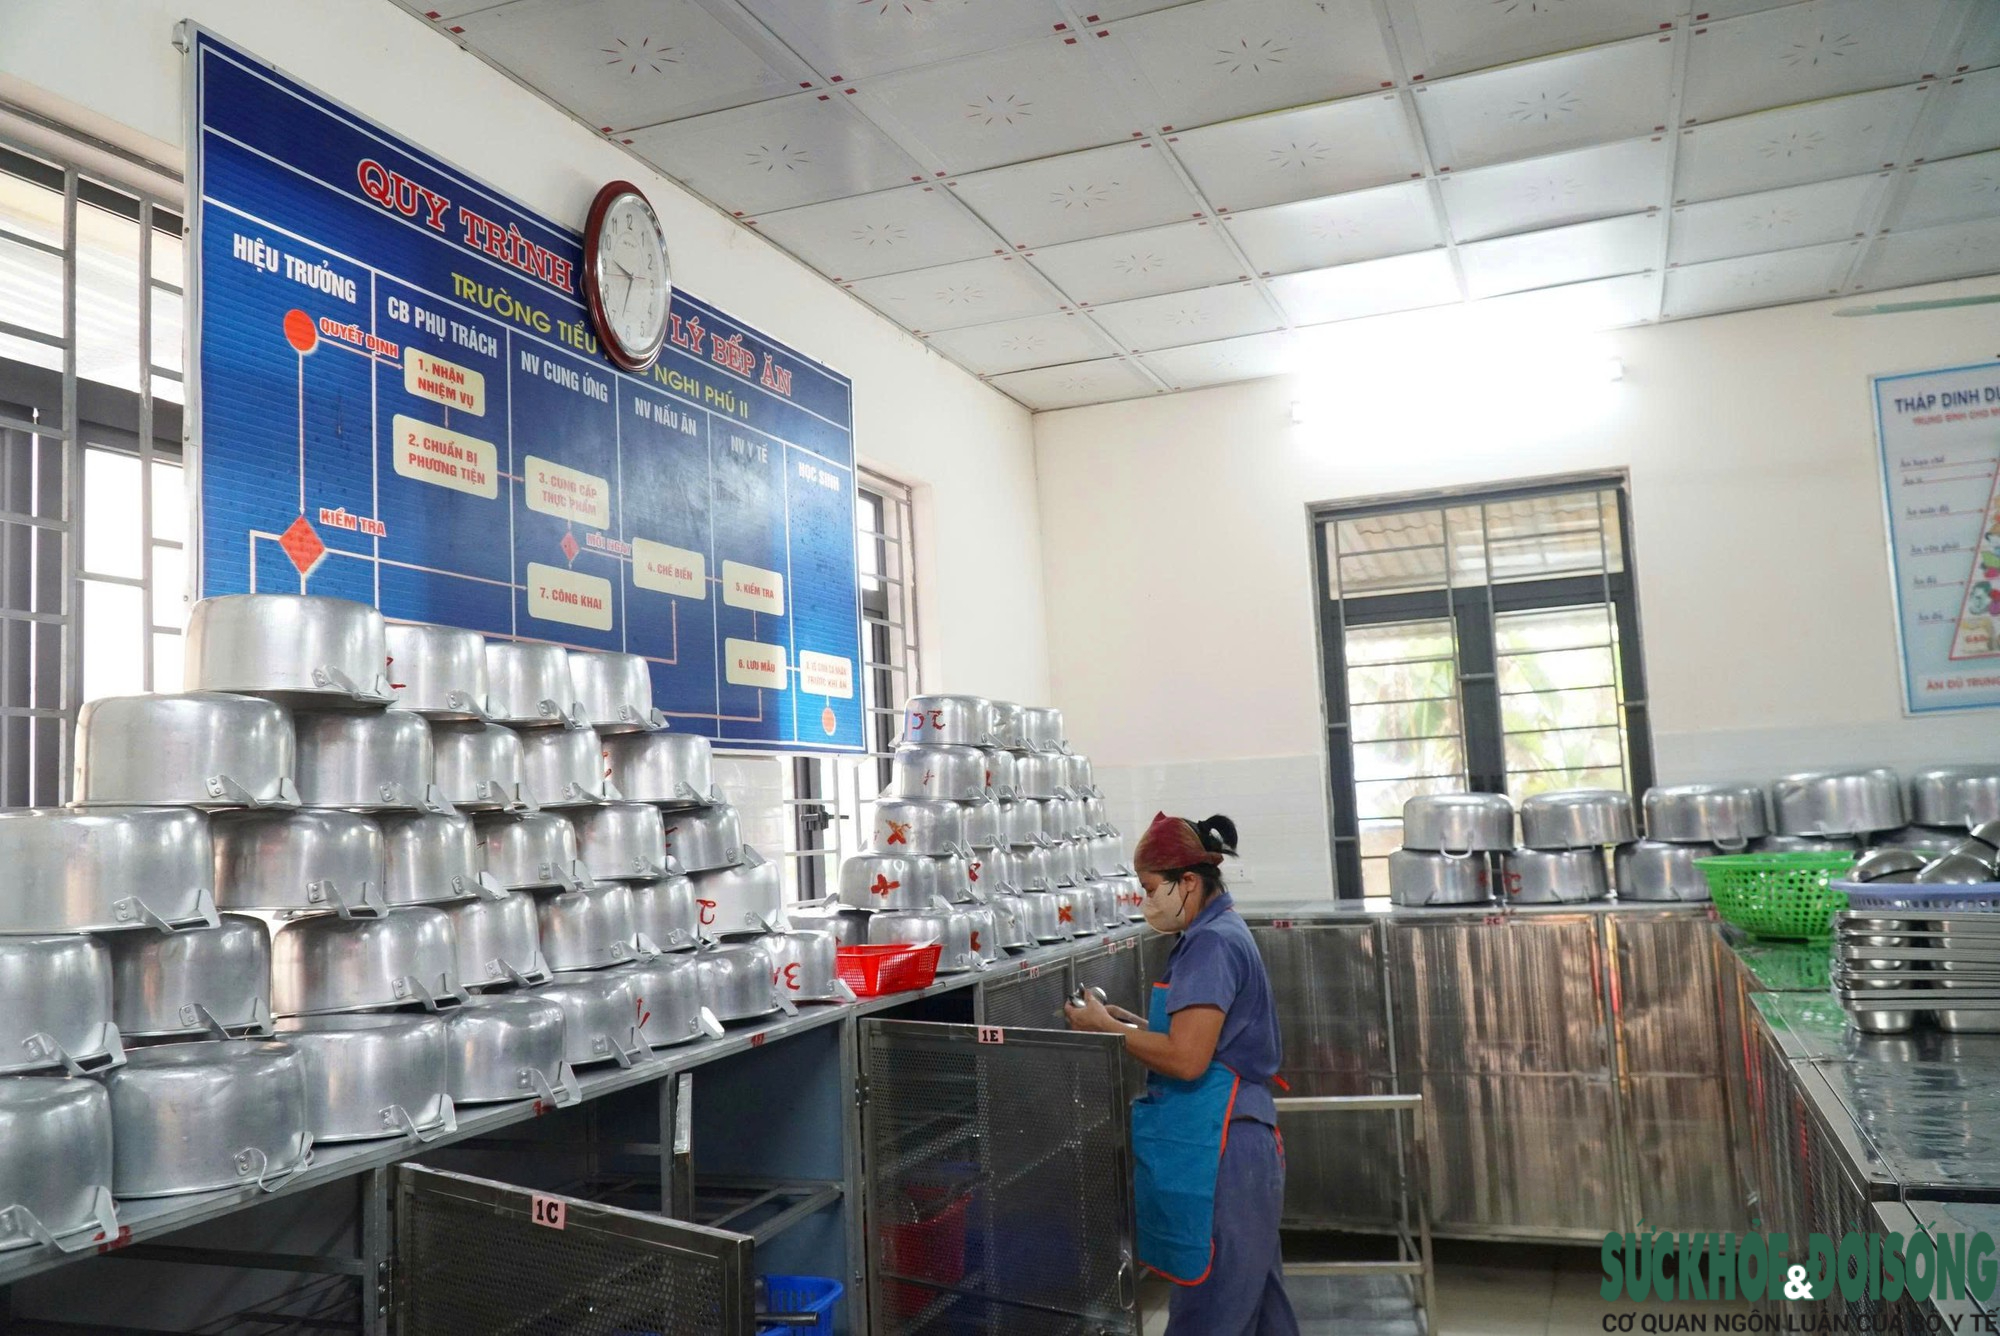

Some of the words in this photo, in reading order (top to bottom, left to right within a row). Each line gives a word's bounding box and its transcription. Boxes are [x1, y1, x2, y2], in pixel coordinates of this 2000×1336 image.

[357, 158, 450, 232] QUY
[459, 206, 573, 293] TRÌNH
[611, 217, 618, 235] 11
[625, 213, 633, 231] 12
[641, 231, 645, 247] 1
[232, 233, 279, 273] HIỆU
[284, 253, 357, 304] TRƯỞNG
[647, 253, 653, 270] 2
[604, 283, 609, 300] 8
[650, 279, 655, 296] 3
[450, 271, 552, 333] TRƯỜNG
[557, 320, 598, 354] TIỂU
[647, 303, 652, 319] 4
[319, 317, 364, 346] QUYẾT
[365, 333, 399, 359] ĐỊNH
[387, 296, 410, 324] CB
[414, 311, 447, 341] PHỤ
[449, 320, 498, 359] TRÁCH
[625, 325, 631, 341] 6
[640, 321, 645, 337] 5
[671, 314, 706, 354] LÝ
[711, 331, 756, 377] BẾP
[760, 353, 792, 396] ĂN
[418, 358, 429, 373] 1.
[432, 363, 465, 385] NHẬN
[521, 350, 540, 376] NV
[543, 359, 579, 391] CUNG
[582, 372, 609, 403] ỨNG
[417, 377, 456, 400] NHIỆM
[459, 391, 474, 409] VỤ
[655, 363, 700, 398] NGHI
[705, 385, 735, 412] PHÚ
[740, 400, 748, 419] II
[1894, 391, 1936, 414] THÁP
[1941, 388, 1980, 408] DINH
[635, 397, 651, 419] NV
[654, 403, 678, 429] NẤU
[681, 412, 697, 437] ĂN
[408, 433, 419, 447] 2.
[423, 437, 463, 460] CHUẨN
[466, 450, 478, 467] BỊ
[731, 434, 745, 455] NV
[747, 440, 754, 458] Y
[756, 442, 768, 464] TẾ
[408, 453, 457, 477] PHƯƠNG
[460, 467, 485, 485] TIỆN
[538, 472, 548, 484] 3.
[550, 475, 577, 493] CUNG
[579, 484, 597, 499] CẤP
[319, 507, 357, 531] KIỂM
[359, 516, 387, 537] TRA
[647, 563, 655, 573] 4.
[657, 563, 672, 577] CHẾ
[674, 568, 693, 581] BIẾN
[539, 587, 549, 599] 7.
[552, 588, 578, 605] CÔNG
[580, 595, 602, 610] KHAI
[735, 582, 743, 593] 5.
[743, 582, 761, 596] KIỂM
[762, 588, 775, 599] TRA
[738, 658, 745, 669] 6.
[982, 1029, 998, 1042] 1E
[536, 1199, 559, 1224] 1C
